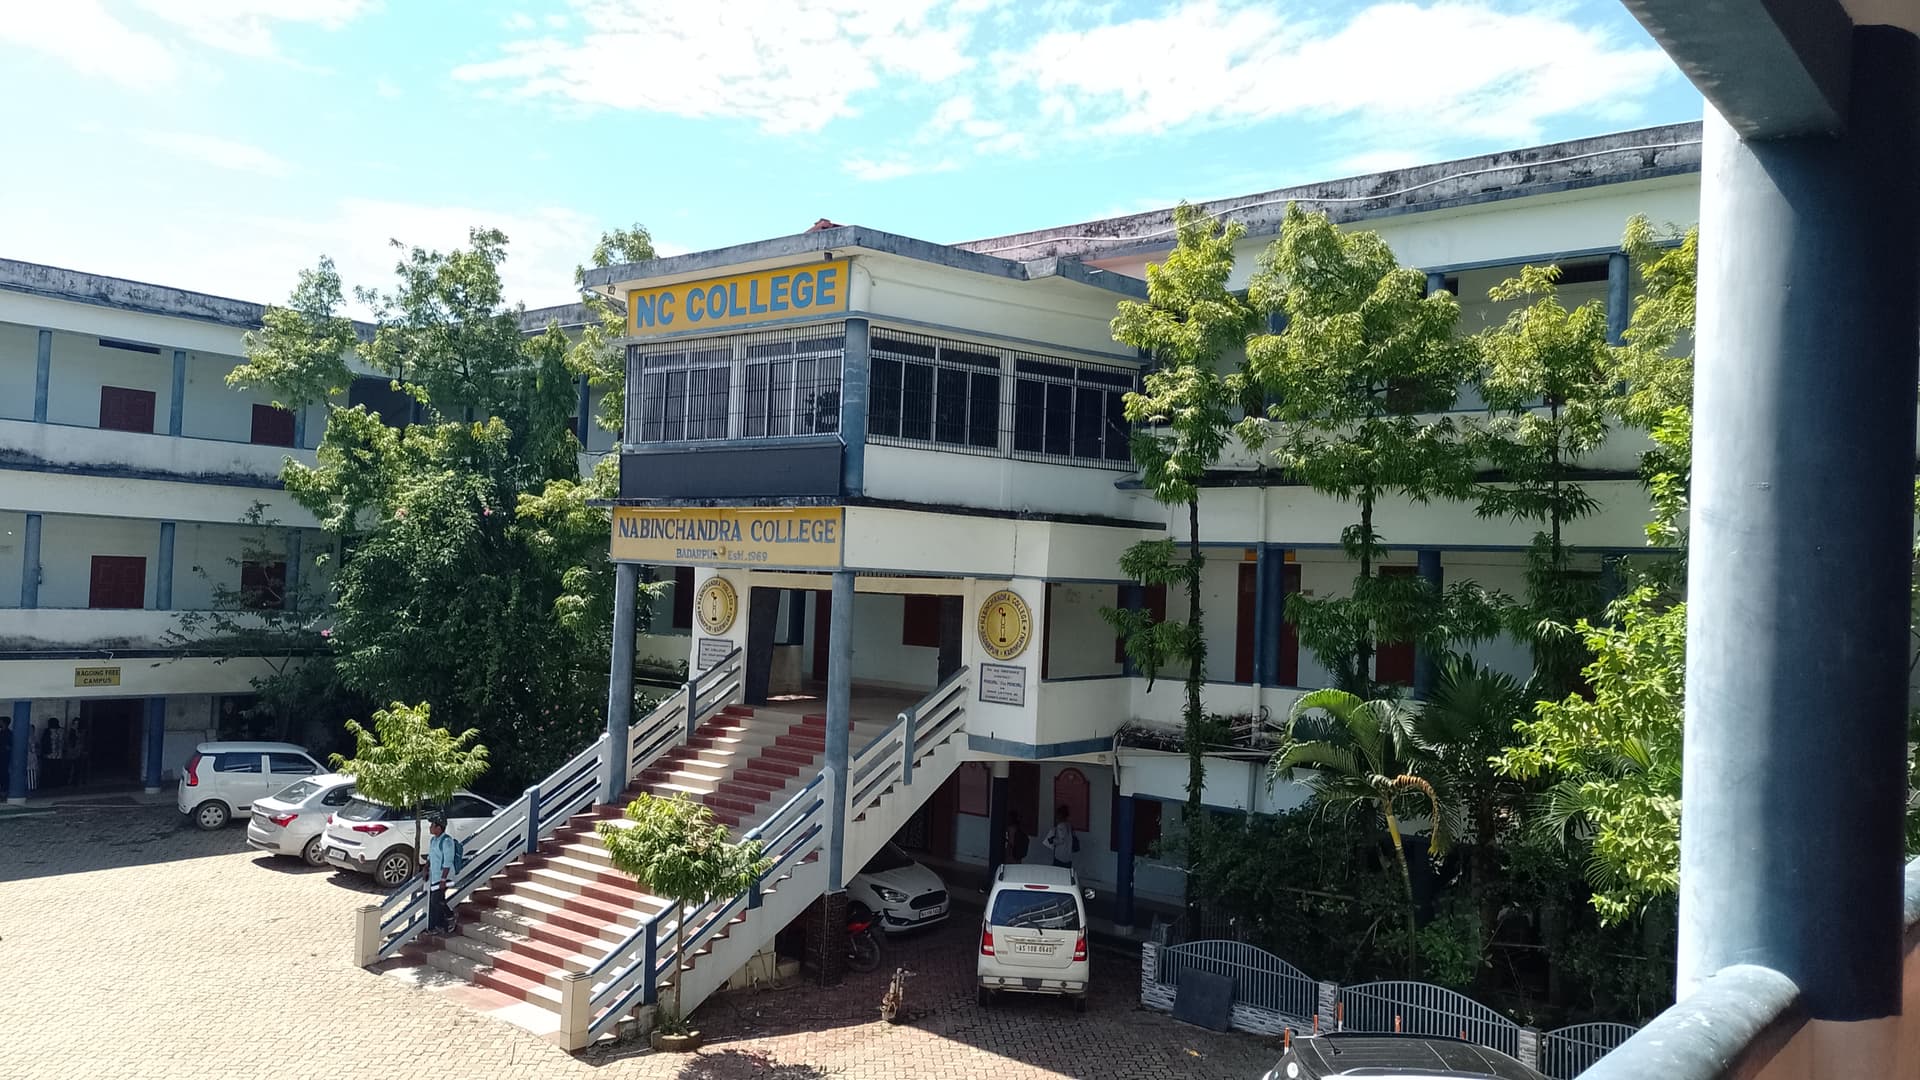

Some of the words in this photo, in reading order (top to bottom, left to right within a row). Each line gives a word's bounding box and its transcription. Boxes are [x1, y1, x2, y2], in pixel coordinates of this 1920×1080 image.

[637, 292, 675, 328] NC
[686, 268, 837, 322] COLLEGE
[618, 517, 742, 542] NABINCHANDRA
[750, 519, 836, 544] COLLEGE
[1011, 597, 1028, 624] COLLEGE
